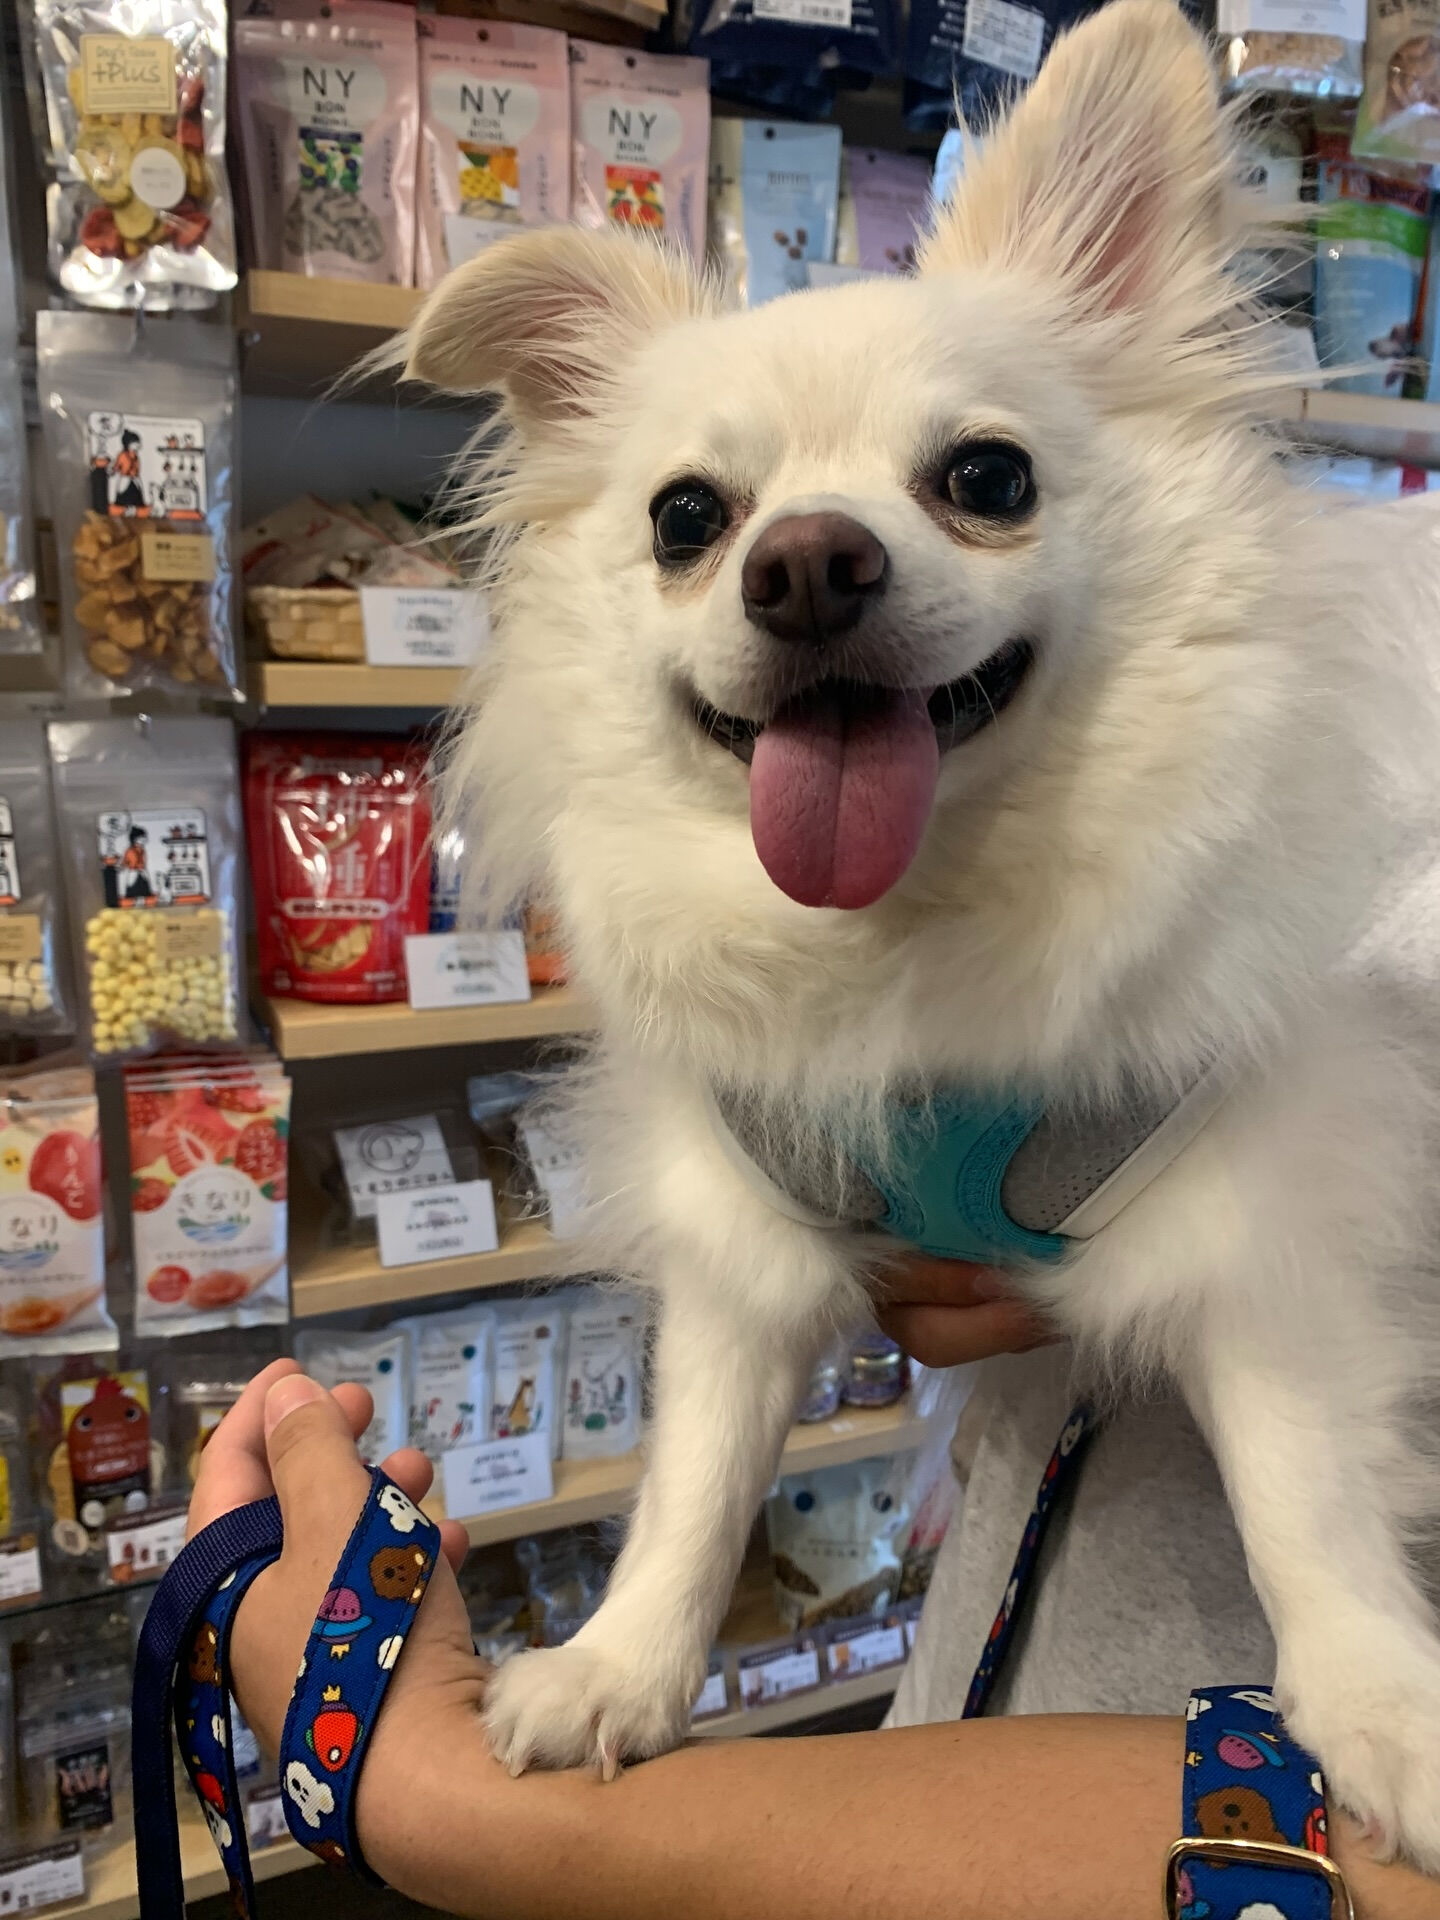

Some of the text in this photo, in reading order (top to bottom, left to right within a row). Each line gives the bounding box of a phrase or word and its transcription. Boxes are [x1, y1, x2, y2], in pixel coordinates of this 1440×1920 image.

[303, 66, 355, 98] NY
[460, 84, 512, 115] NY
[608, 107, 657, 139] NY
